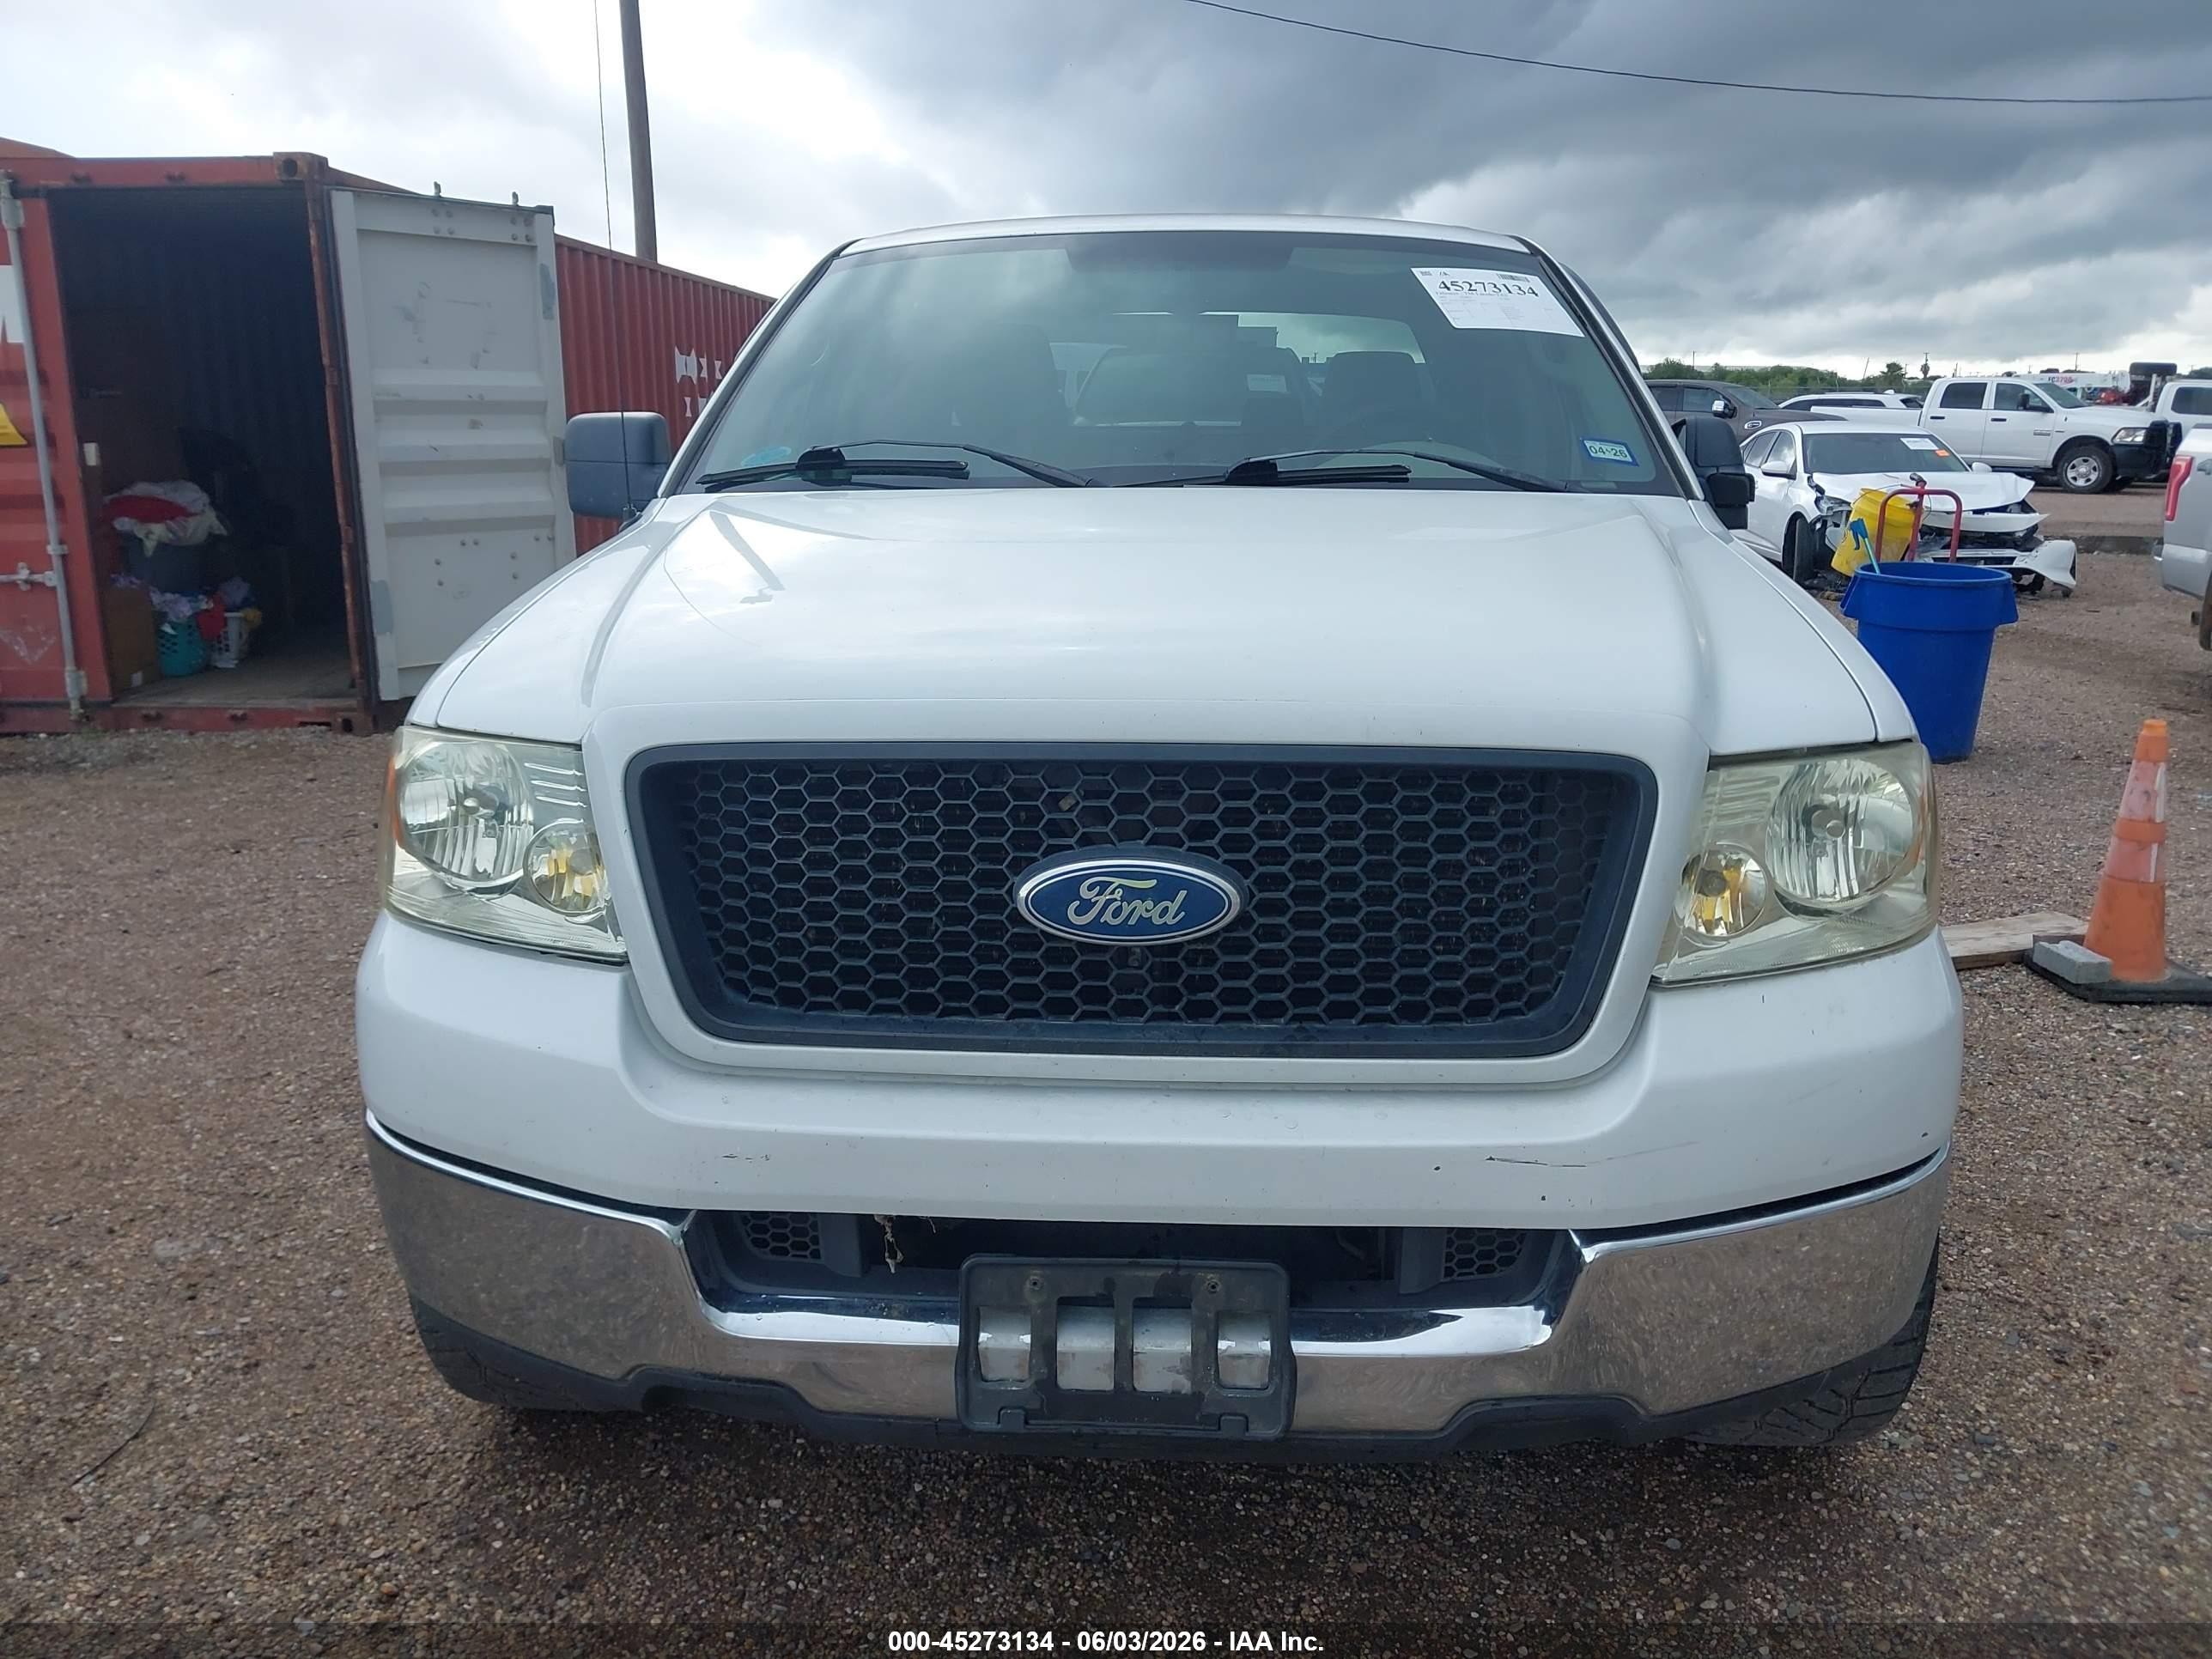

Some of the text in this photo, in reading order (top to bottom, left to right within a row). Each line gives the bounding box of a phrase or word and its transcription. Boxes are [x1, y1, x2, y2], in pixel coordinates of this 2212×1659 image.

[1438, 280, 1540, 297] 45273134
[1589, 445, 1628, 459] 04-26
[1067, 876, 1188, 926] Ford
